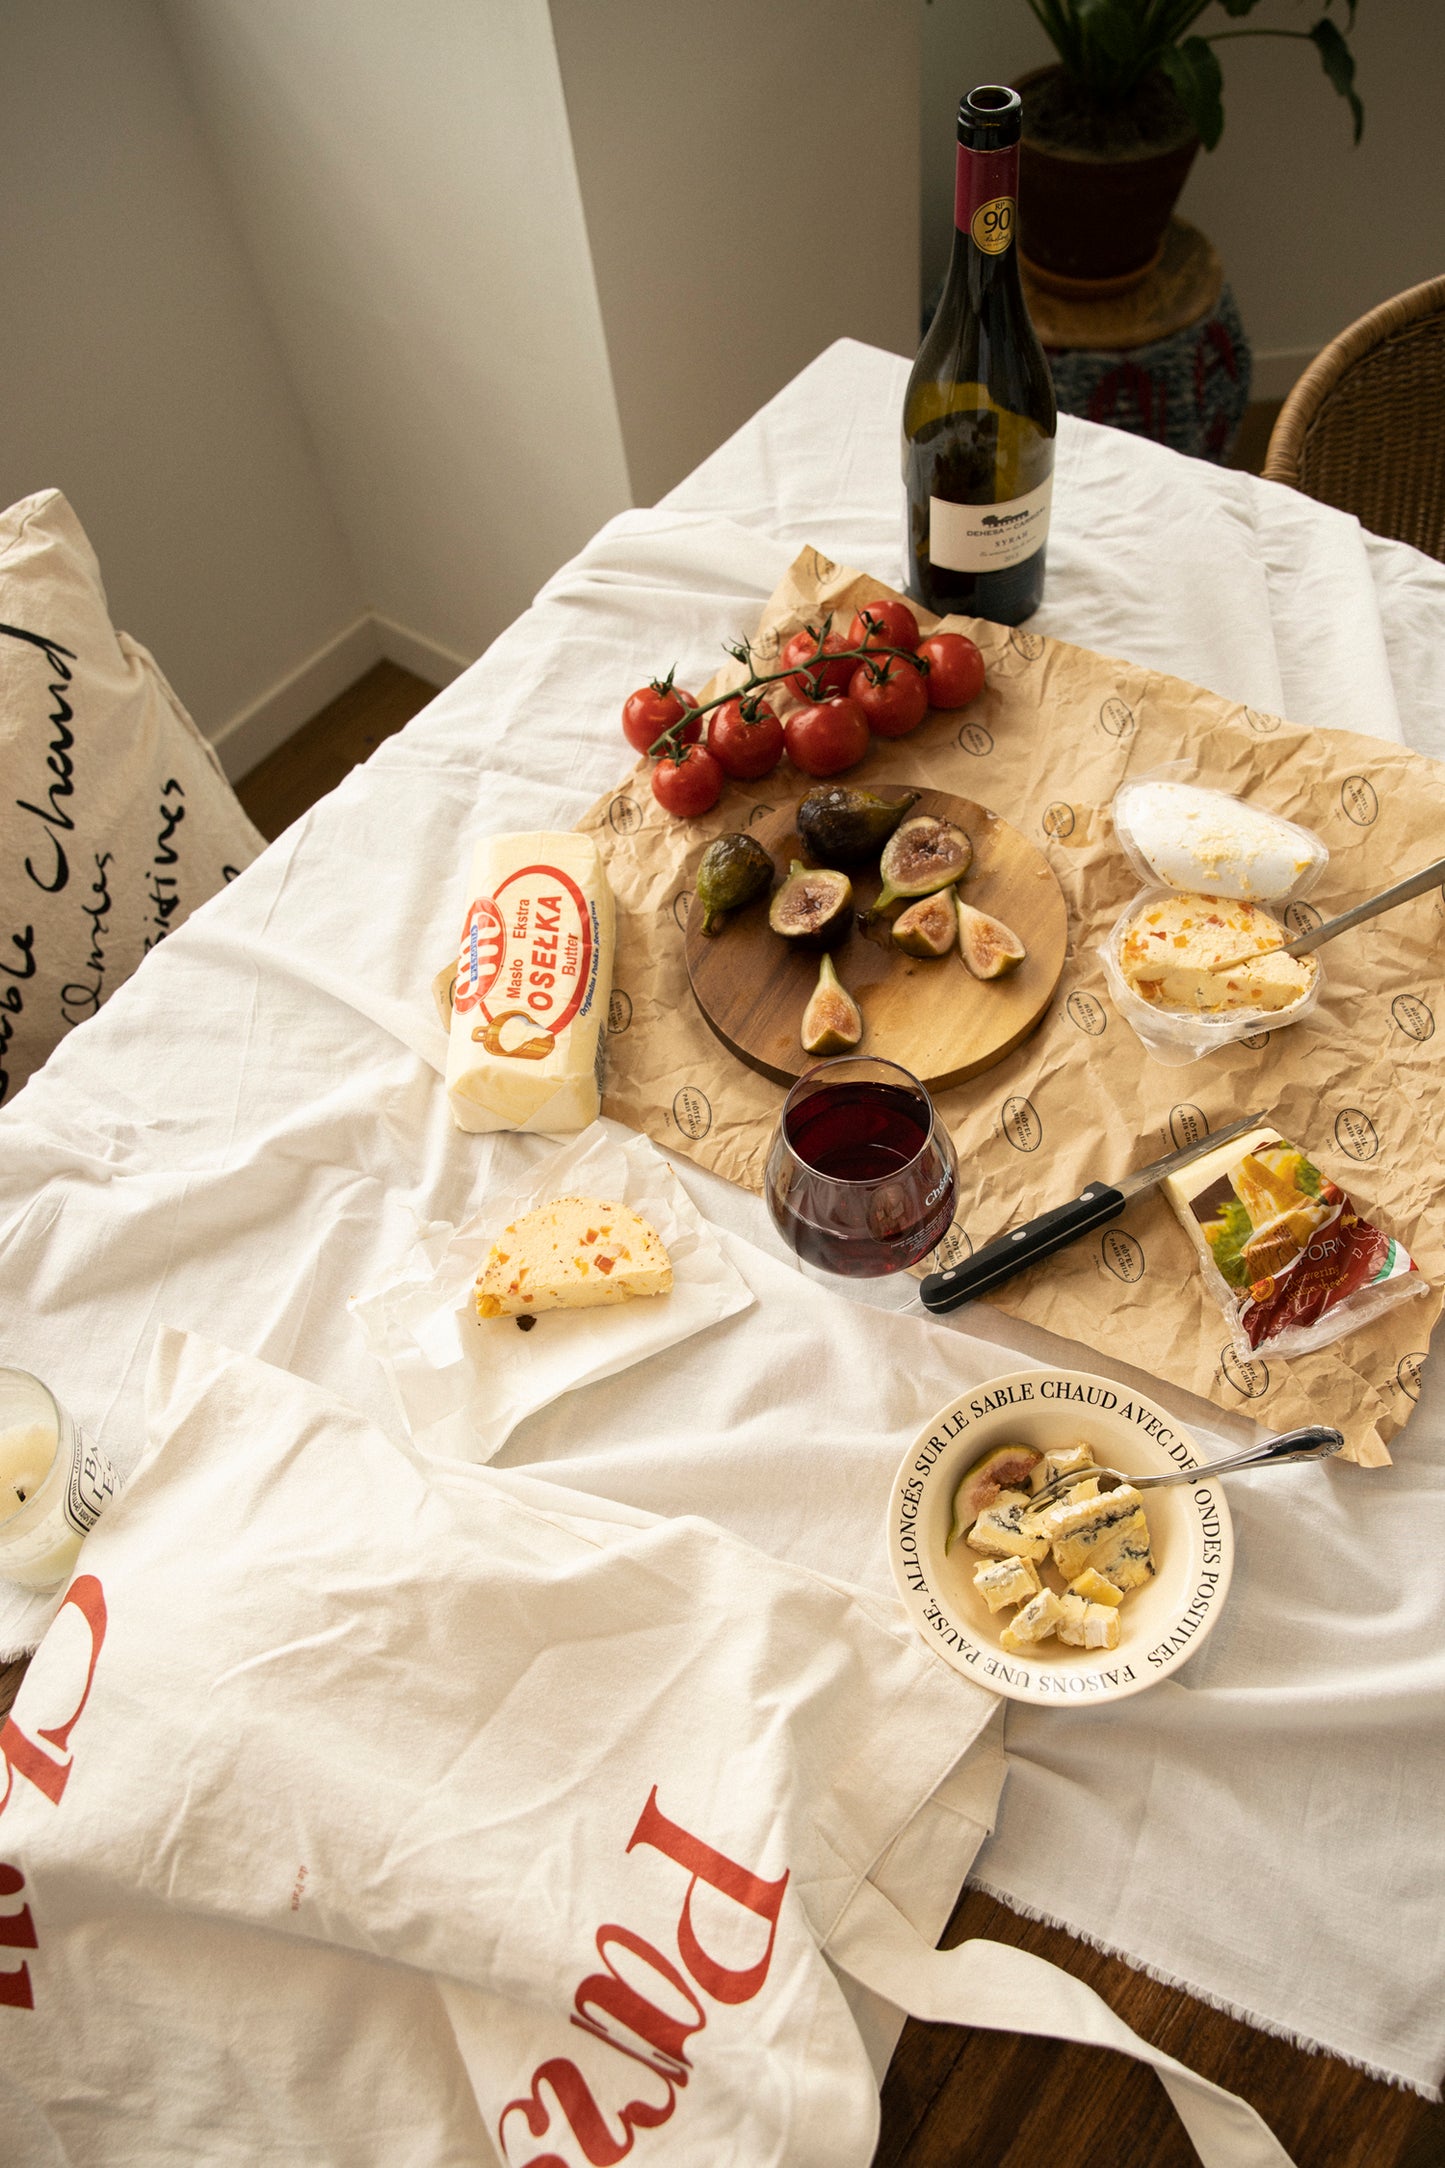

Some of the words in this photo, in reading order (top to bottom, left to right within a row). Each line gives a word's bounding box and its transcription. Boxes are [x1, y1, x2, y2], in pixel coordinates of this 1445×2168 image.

[983, 207, 1010, 234] 90
[995, 530, 1028, 548] SYRAH
[513, 899, 530, 939] Ekstra
[528, 896, 562, 1011] OSEŁKA
[562, 933, 578, 976] Butter
[506, 959, 524, 999] Masło
[683, 1093, 691, 1113] PARIS
[687, 1113, 697, 1135] CHILL
[691, 1100, 701, 1124] HÔTEL
[1010, 1104, 1021, 1126] PARIS
[1016, 1125, 1027, 1147] CHILL
[1020, 1111, 1032, 1137] HÔTEL
[1178, 1109, 1188, 1130] PARIS
[1343, 1117, 1355, 1138] PARIS
[1353, 1137, 1364, 1158] CHILL
[1354, 1123, 1368, 1147] HÔTEL
[1110, 1238, 1122, 1259] PARIS
[1118, 1258, 1130, 1279] CHILL
[1120, 1243, 1134, 1269] HÔTEL
[1229, 1350, 1241, 1370] PARIS
[1244, 1362, 1258, 1382] ÔTEL
[970, 1382, 1035, 1419] SABLE
[1040, 1381, 1118, 1410] CHAUD
[941, 1410, 970, 1440] LE
[1118, 1401, 1174, 1447] AVEC
[914, 1436, 948, 1477] SUR
[900, 1477, 930, 1594] ALLONGÉS
[1194, 1488, 1222, 1565] ONDES
[923, 1598, 982, 1666] PAUSE,
[1147, 1570, 1220, 1669] POSITIVES
[983, 1657, 1031, 1689] UNE
[1040, 1664, 1137, 1694] FAISONS
